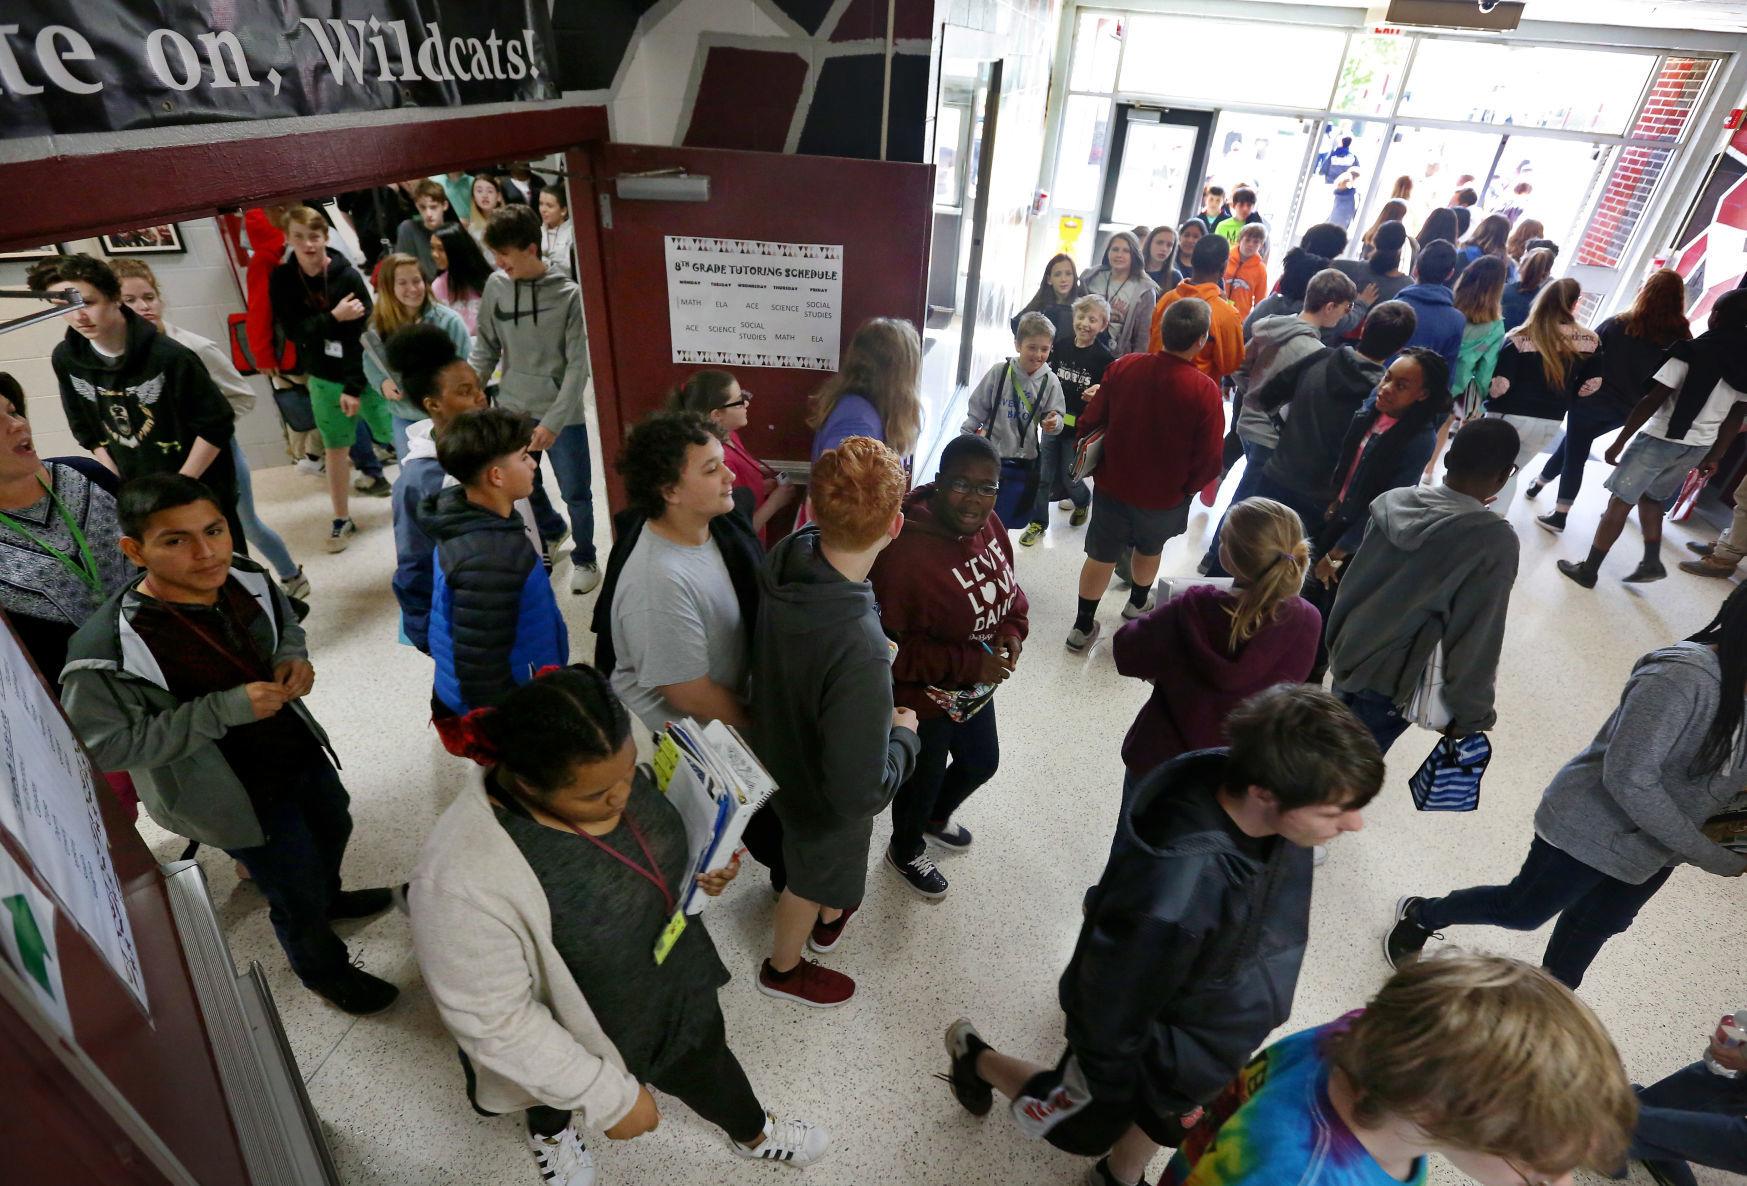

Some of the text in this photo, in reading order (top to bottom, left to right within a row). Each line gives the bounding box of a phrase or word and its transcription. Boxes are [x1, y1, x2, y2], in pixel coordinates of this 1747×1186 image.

[146, 28, 282, 97] on,
[299, 14, 540, 86] Wildcats!
[692, 263, 727, 274] GRADE
[729, 265, 783, 276] TUTORING
[784, 267, 838, 280] SCHEDULE
[680, 298, 702, 306] MATH
[745, 302, 759, 310] ACE
[771, 304, 799, 312] SCIENCE
[806, 301, 831, 309] SOCIAL
[804, 311, 832, 319] STUDIES
[685, 321, 765, 334] ACE SCIENCE SOCIAL
[739, 333, 767, 341] STUDIES
[811, 335, 824, 343] ELA
[952, 538, 1006, 590] LIVE
